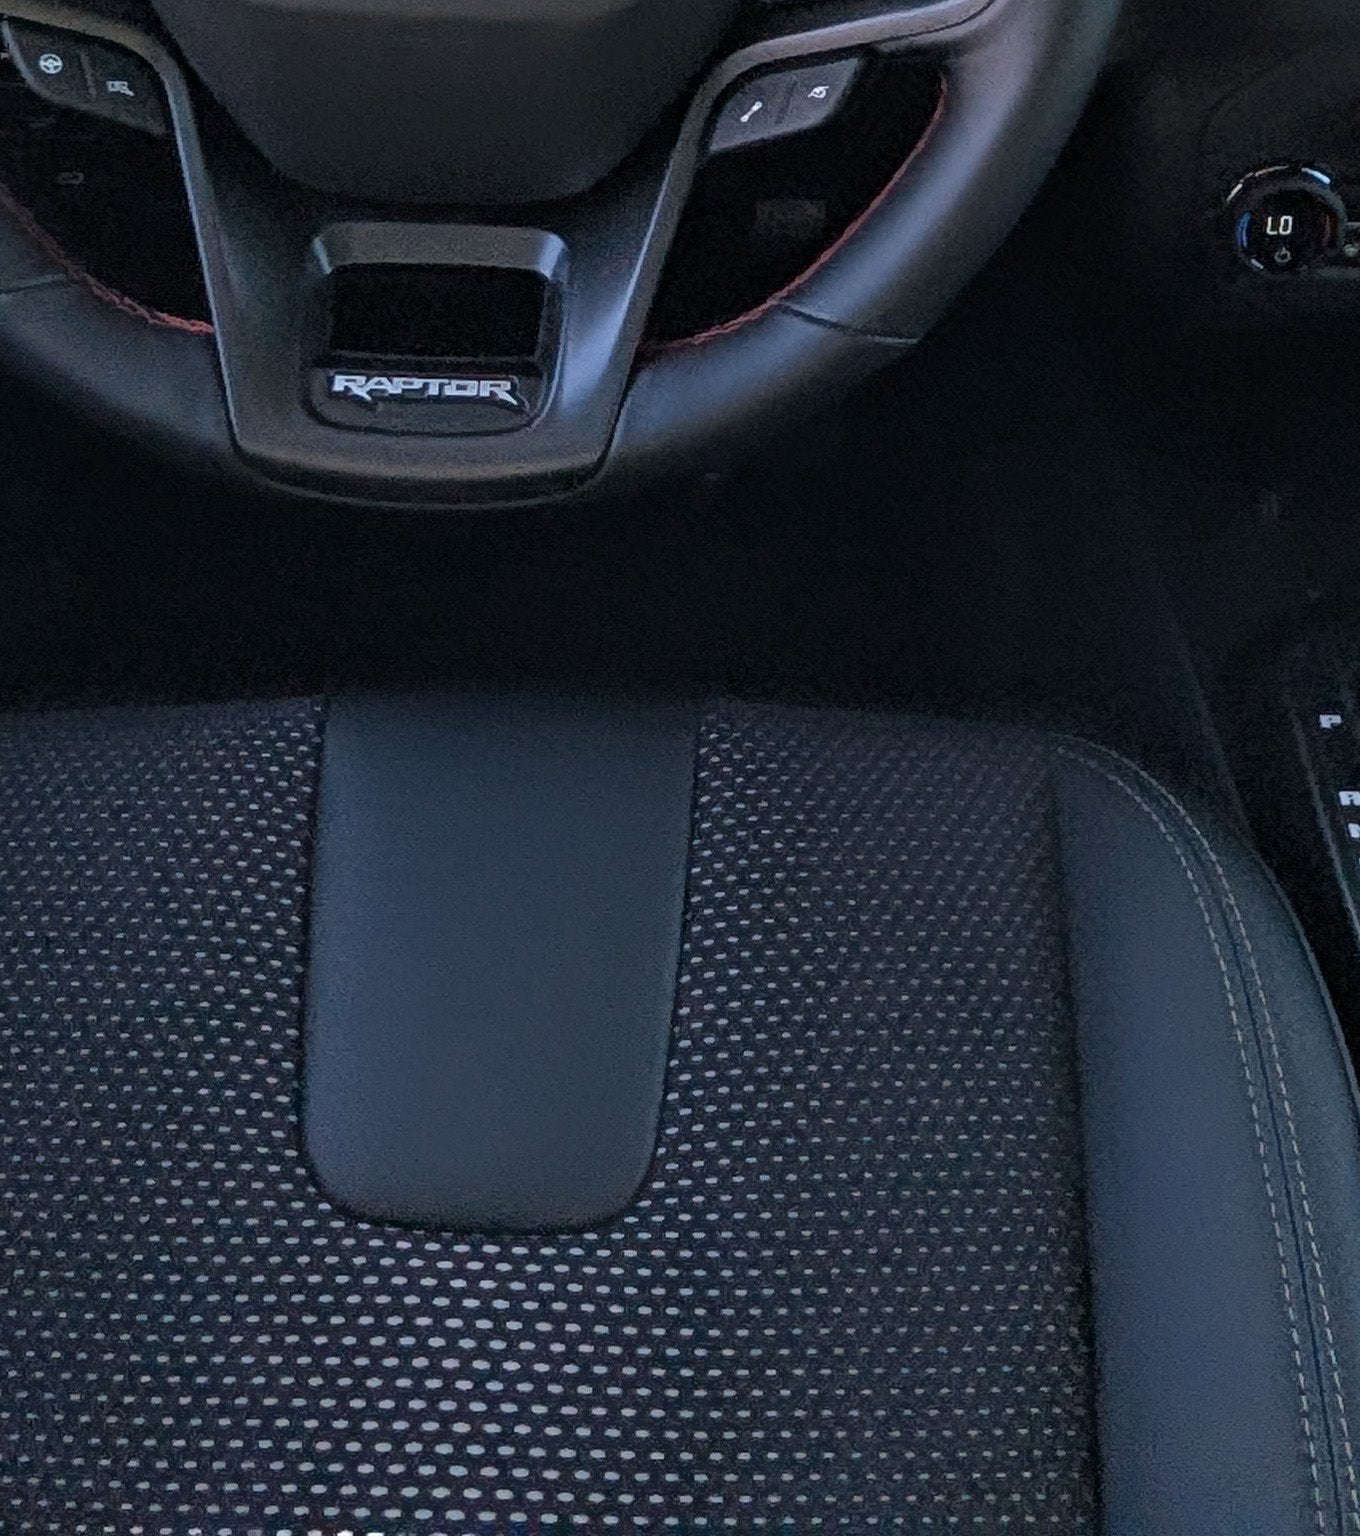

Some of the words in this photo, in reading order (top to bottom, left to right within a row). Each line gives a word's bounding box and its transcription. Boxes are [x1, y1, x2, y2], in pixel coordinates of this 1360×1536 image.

[1266, 215, 1293, 235] LO
[331, 375, 518, 405] RAPTOR
[1319, 714, 1342, 728] P
